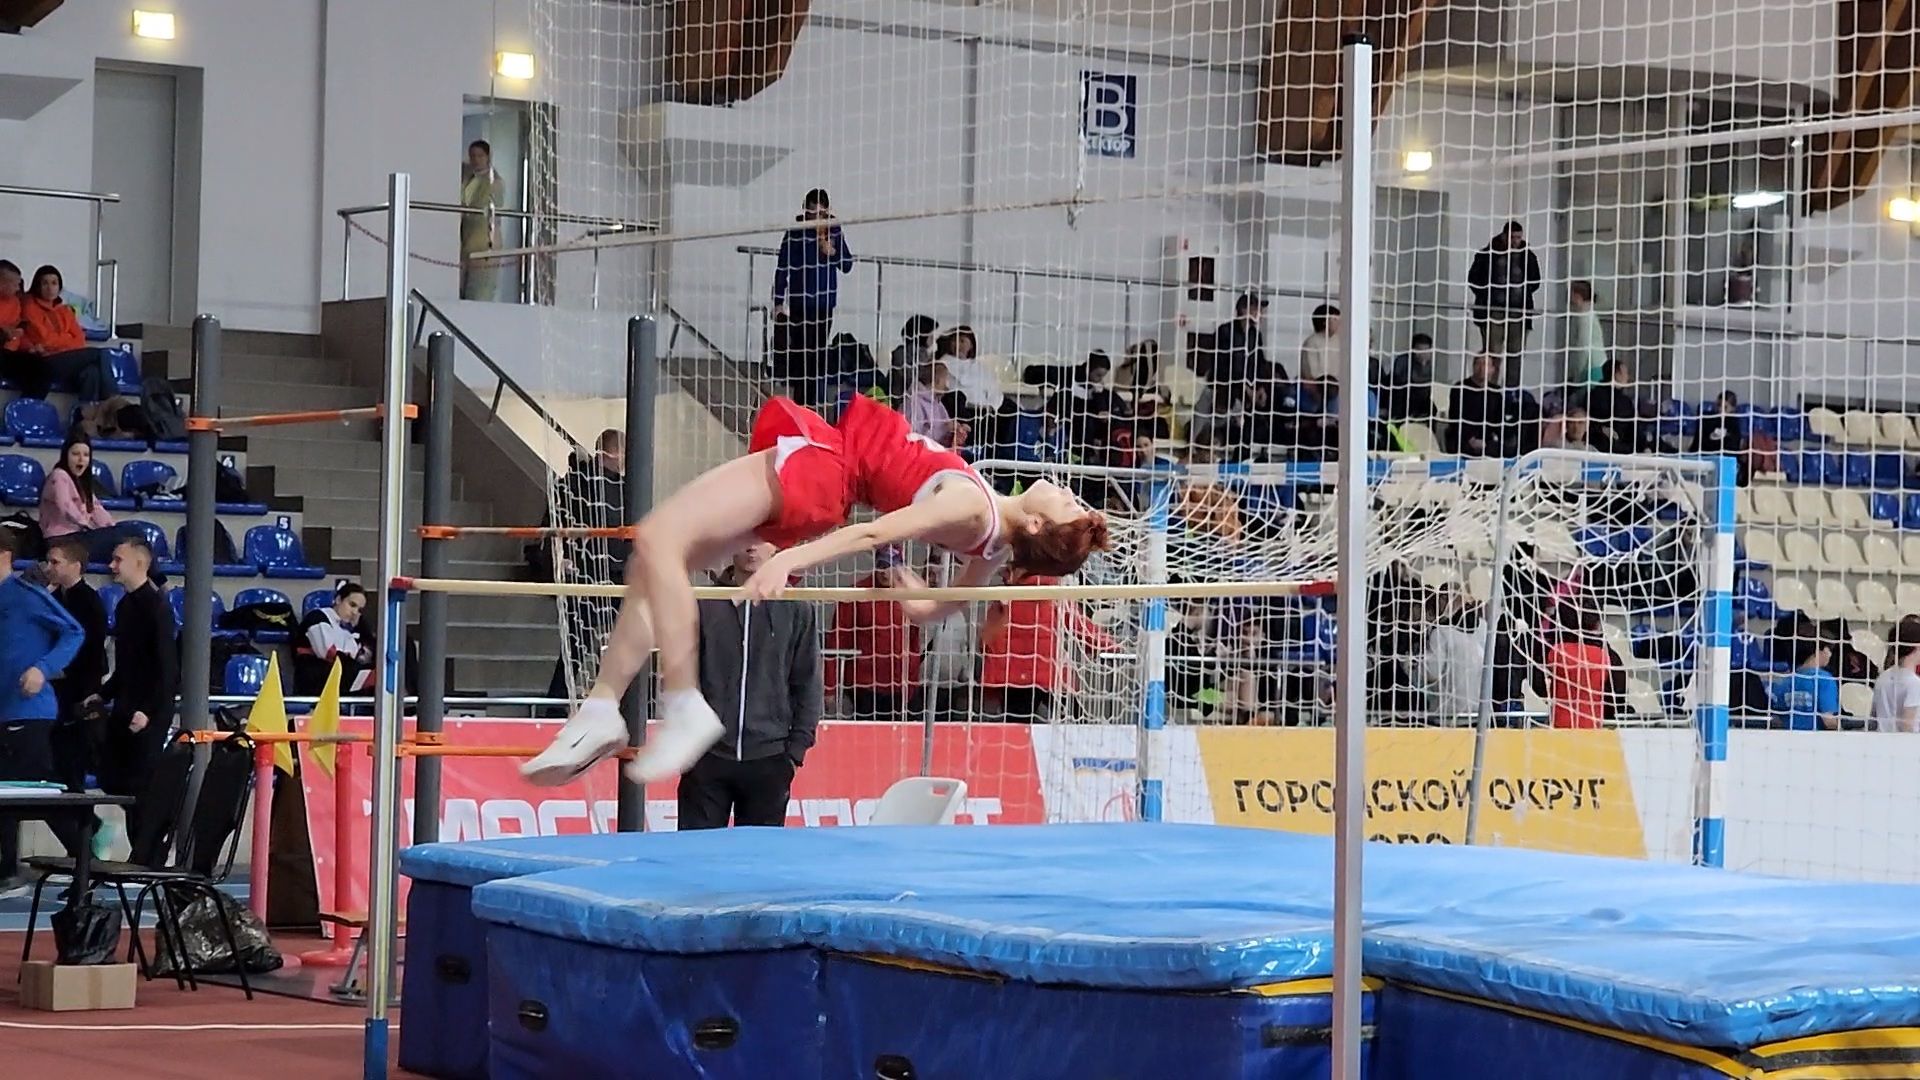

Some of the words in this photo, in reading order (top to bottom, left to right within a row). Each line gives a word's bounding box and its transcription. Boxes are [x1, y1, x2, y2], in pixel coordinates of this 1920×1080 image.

[1087, 81, 1129, 134] В
[279, 517, 289, 530] 5
[1233, 769, 1469, 818] ГОРОСКОЙ
[1489, 778, 1605, 811] ОКРУГ
